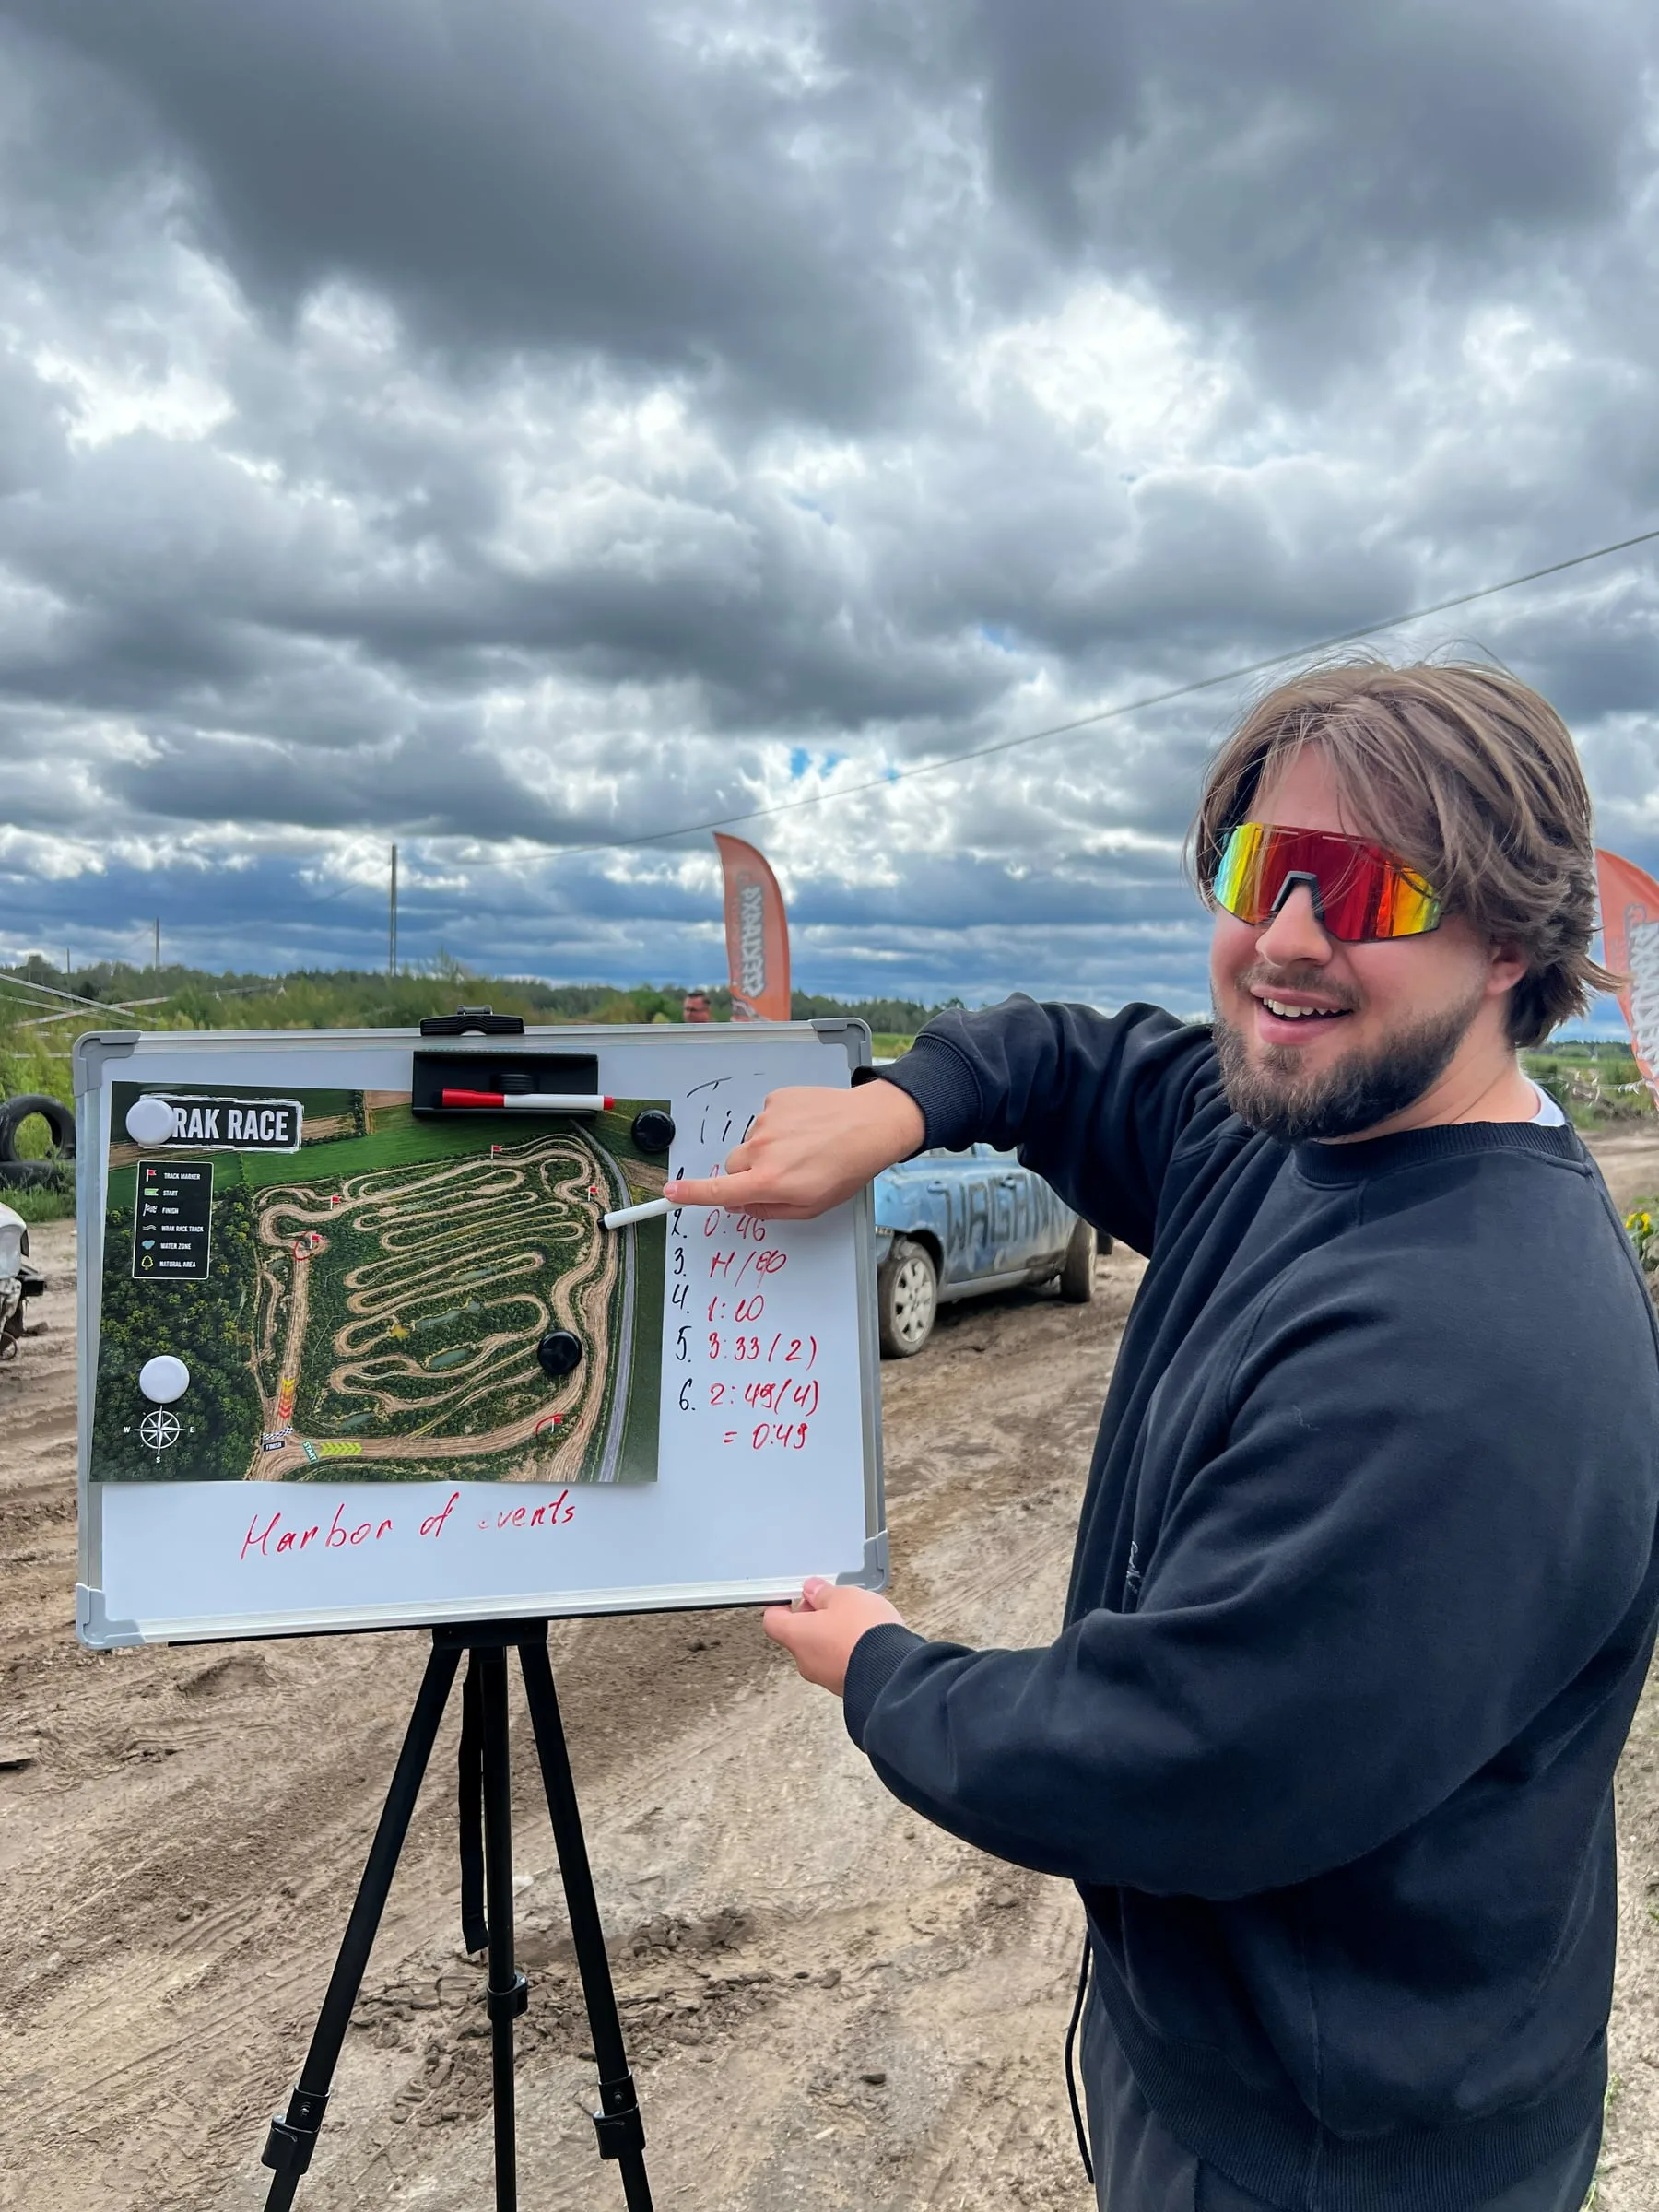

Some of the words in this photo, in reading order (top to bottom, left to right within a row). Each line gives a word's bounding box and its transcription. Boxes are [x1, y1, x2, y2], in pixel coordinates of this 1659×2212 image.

[172, 1107, 220, 1139] RAK
[228, 1109, 288, 1141] RACE
[704, 1209, 766, 1241] 0:46
[674, 1247, 687, 1277] 3.
[672, 1283, 690, 1314] 4.
[675, 1325, 692, 1363] 5.
[678, 1378, 696, 1411] 6.
[302, 1441, 318, 1462] START
[419, 1491, 460, 1538] of
